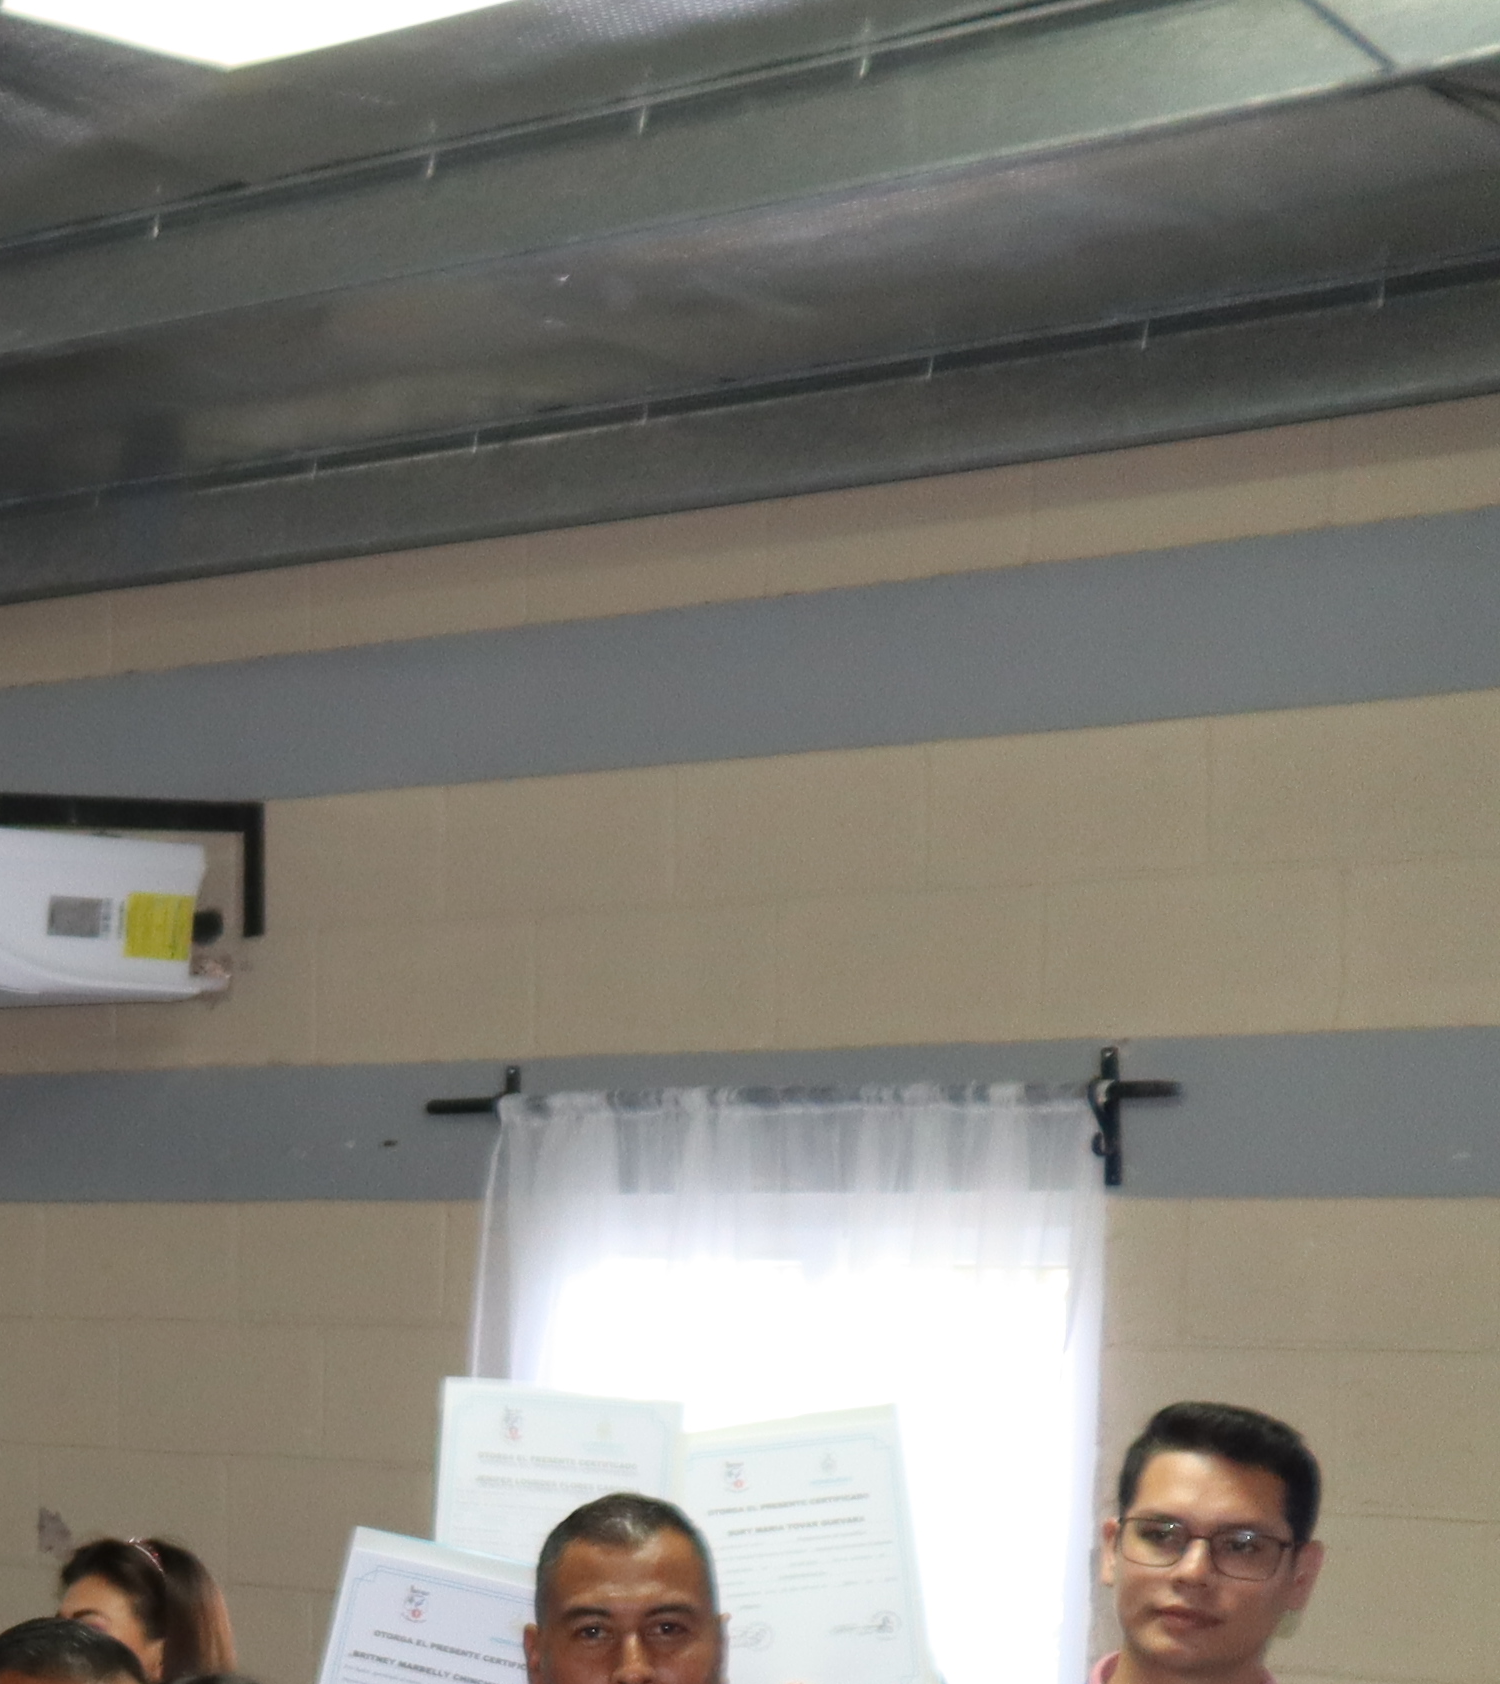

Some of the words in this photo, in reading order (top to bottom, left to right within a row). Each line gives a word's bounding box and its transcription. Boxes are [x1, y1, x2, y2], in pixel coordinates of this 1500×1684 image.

[352, 1650, 397, 1667] BRITNEY
[373, 1629, 414, 1646] OTORGA
[416, 1638, 428, 1648] EL
[430, 1641, 481, 1661] PRESENTE
[483, 1653, 528, 1672] CERTIFIC
